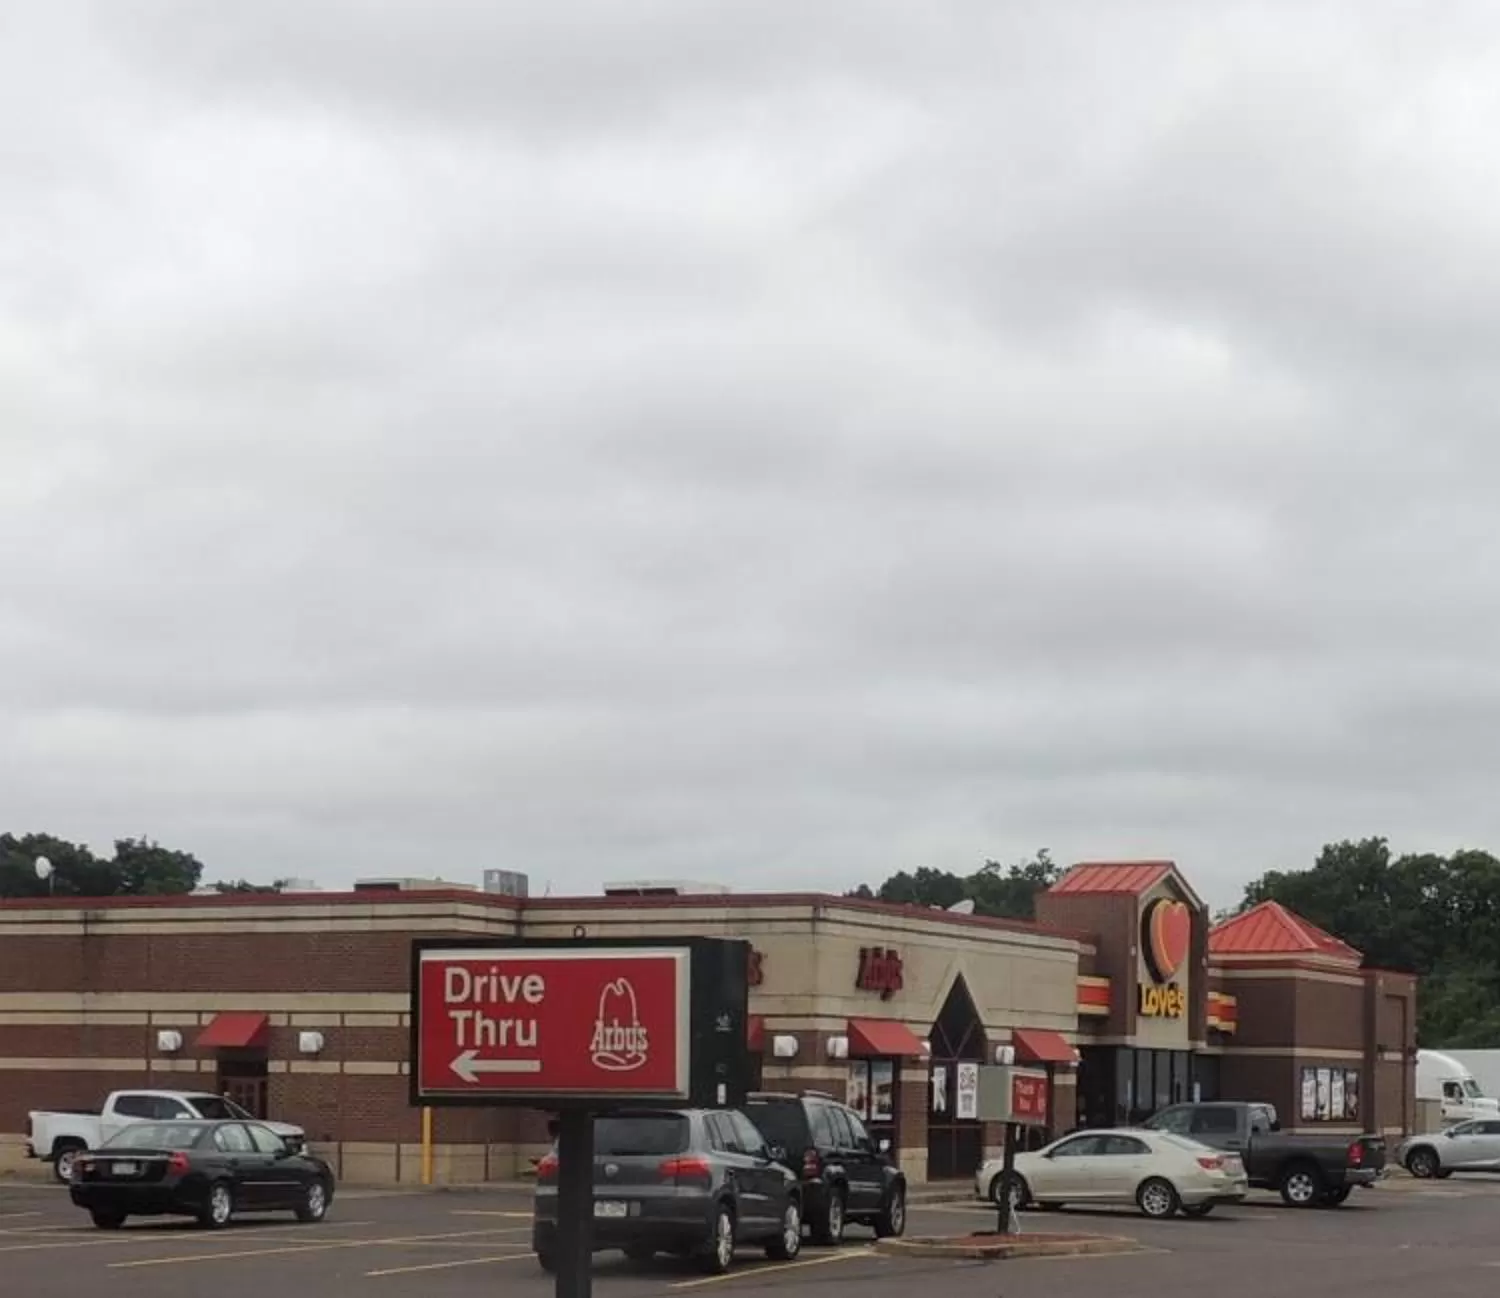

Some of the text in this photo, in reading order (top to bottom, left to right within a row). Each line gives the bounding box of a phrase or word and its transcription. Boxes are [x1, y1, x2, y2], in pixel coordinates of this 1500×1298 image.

[444, 966, 545, 1004] Drive
[1138, 983, 1185, 1018] Love's
[448, 1010, 537, 1047] Thru
[589, 1018, 649, 1057] Arby's
